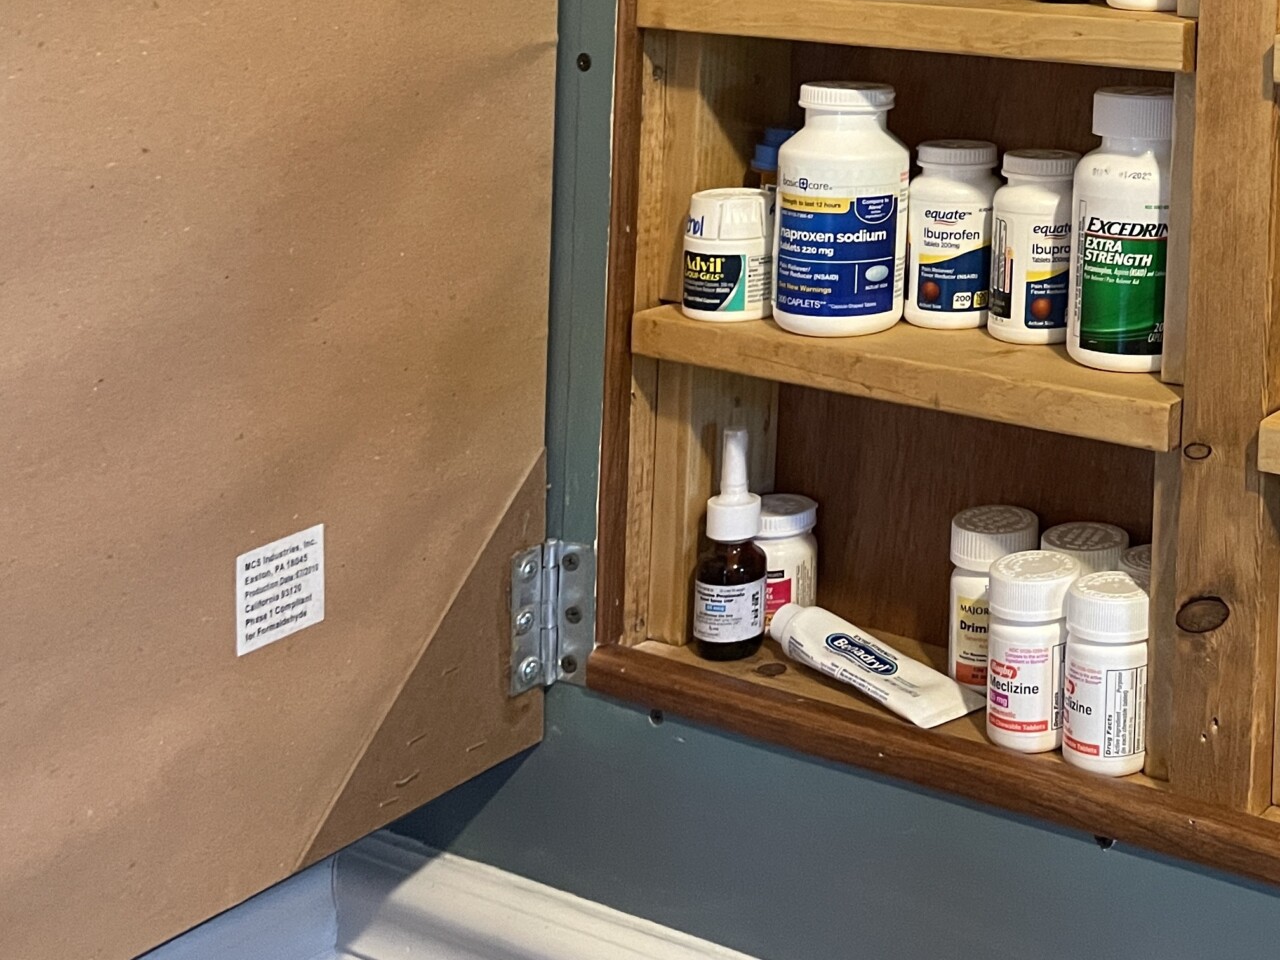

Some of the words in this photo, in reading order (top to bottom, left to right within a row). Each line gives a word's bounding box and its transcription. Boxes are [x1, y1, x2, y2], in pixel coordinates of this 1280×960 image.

[824, 201, 842, 209] hours
[780, 226, 834, 243] naproxen
[836, 228, 887, 243] sodium
[923, 227, 980, 240] Ibuprofen
[802, 246, 817, 254] 220
[818, 248, 834, 257] mg
[924, 240, 940, 248] Tablets
[1032, 244, 1070, 257] Ibupro
[1085, 236, 1122, 253] EXTRA
[687, 254, 722, 273] Advil
[1085, 249, 1153, 266] STRENGTH
[813, 273, 839, 281] (NSAID)
[800, 284, 832, 294] Warnings
[245, 558, 261, 571] MCS
[263, 544, 301, 564] Industries,
[303, 539, 317, 549] Inc.
[245, 570, 274, 585] Easton,
[275, 563, 285, 573] PA
[245, 580, 279, 599] Production
[279, 575, 294, 586] Date
[245, 594, 279, 614] California
[245, 613, 267, 628] Phase
[275, 594, 312, 615] Compliant
[245, 631, 255, 641] for
[257, 610, 307, 634] Formaldehyde
[833, 637, 893, 671] Benadryl
[990, 674, 1039, 695] Meclizine
[996, 696, 1008, 707] mg
